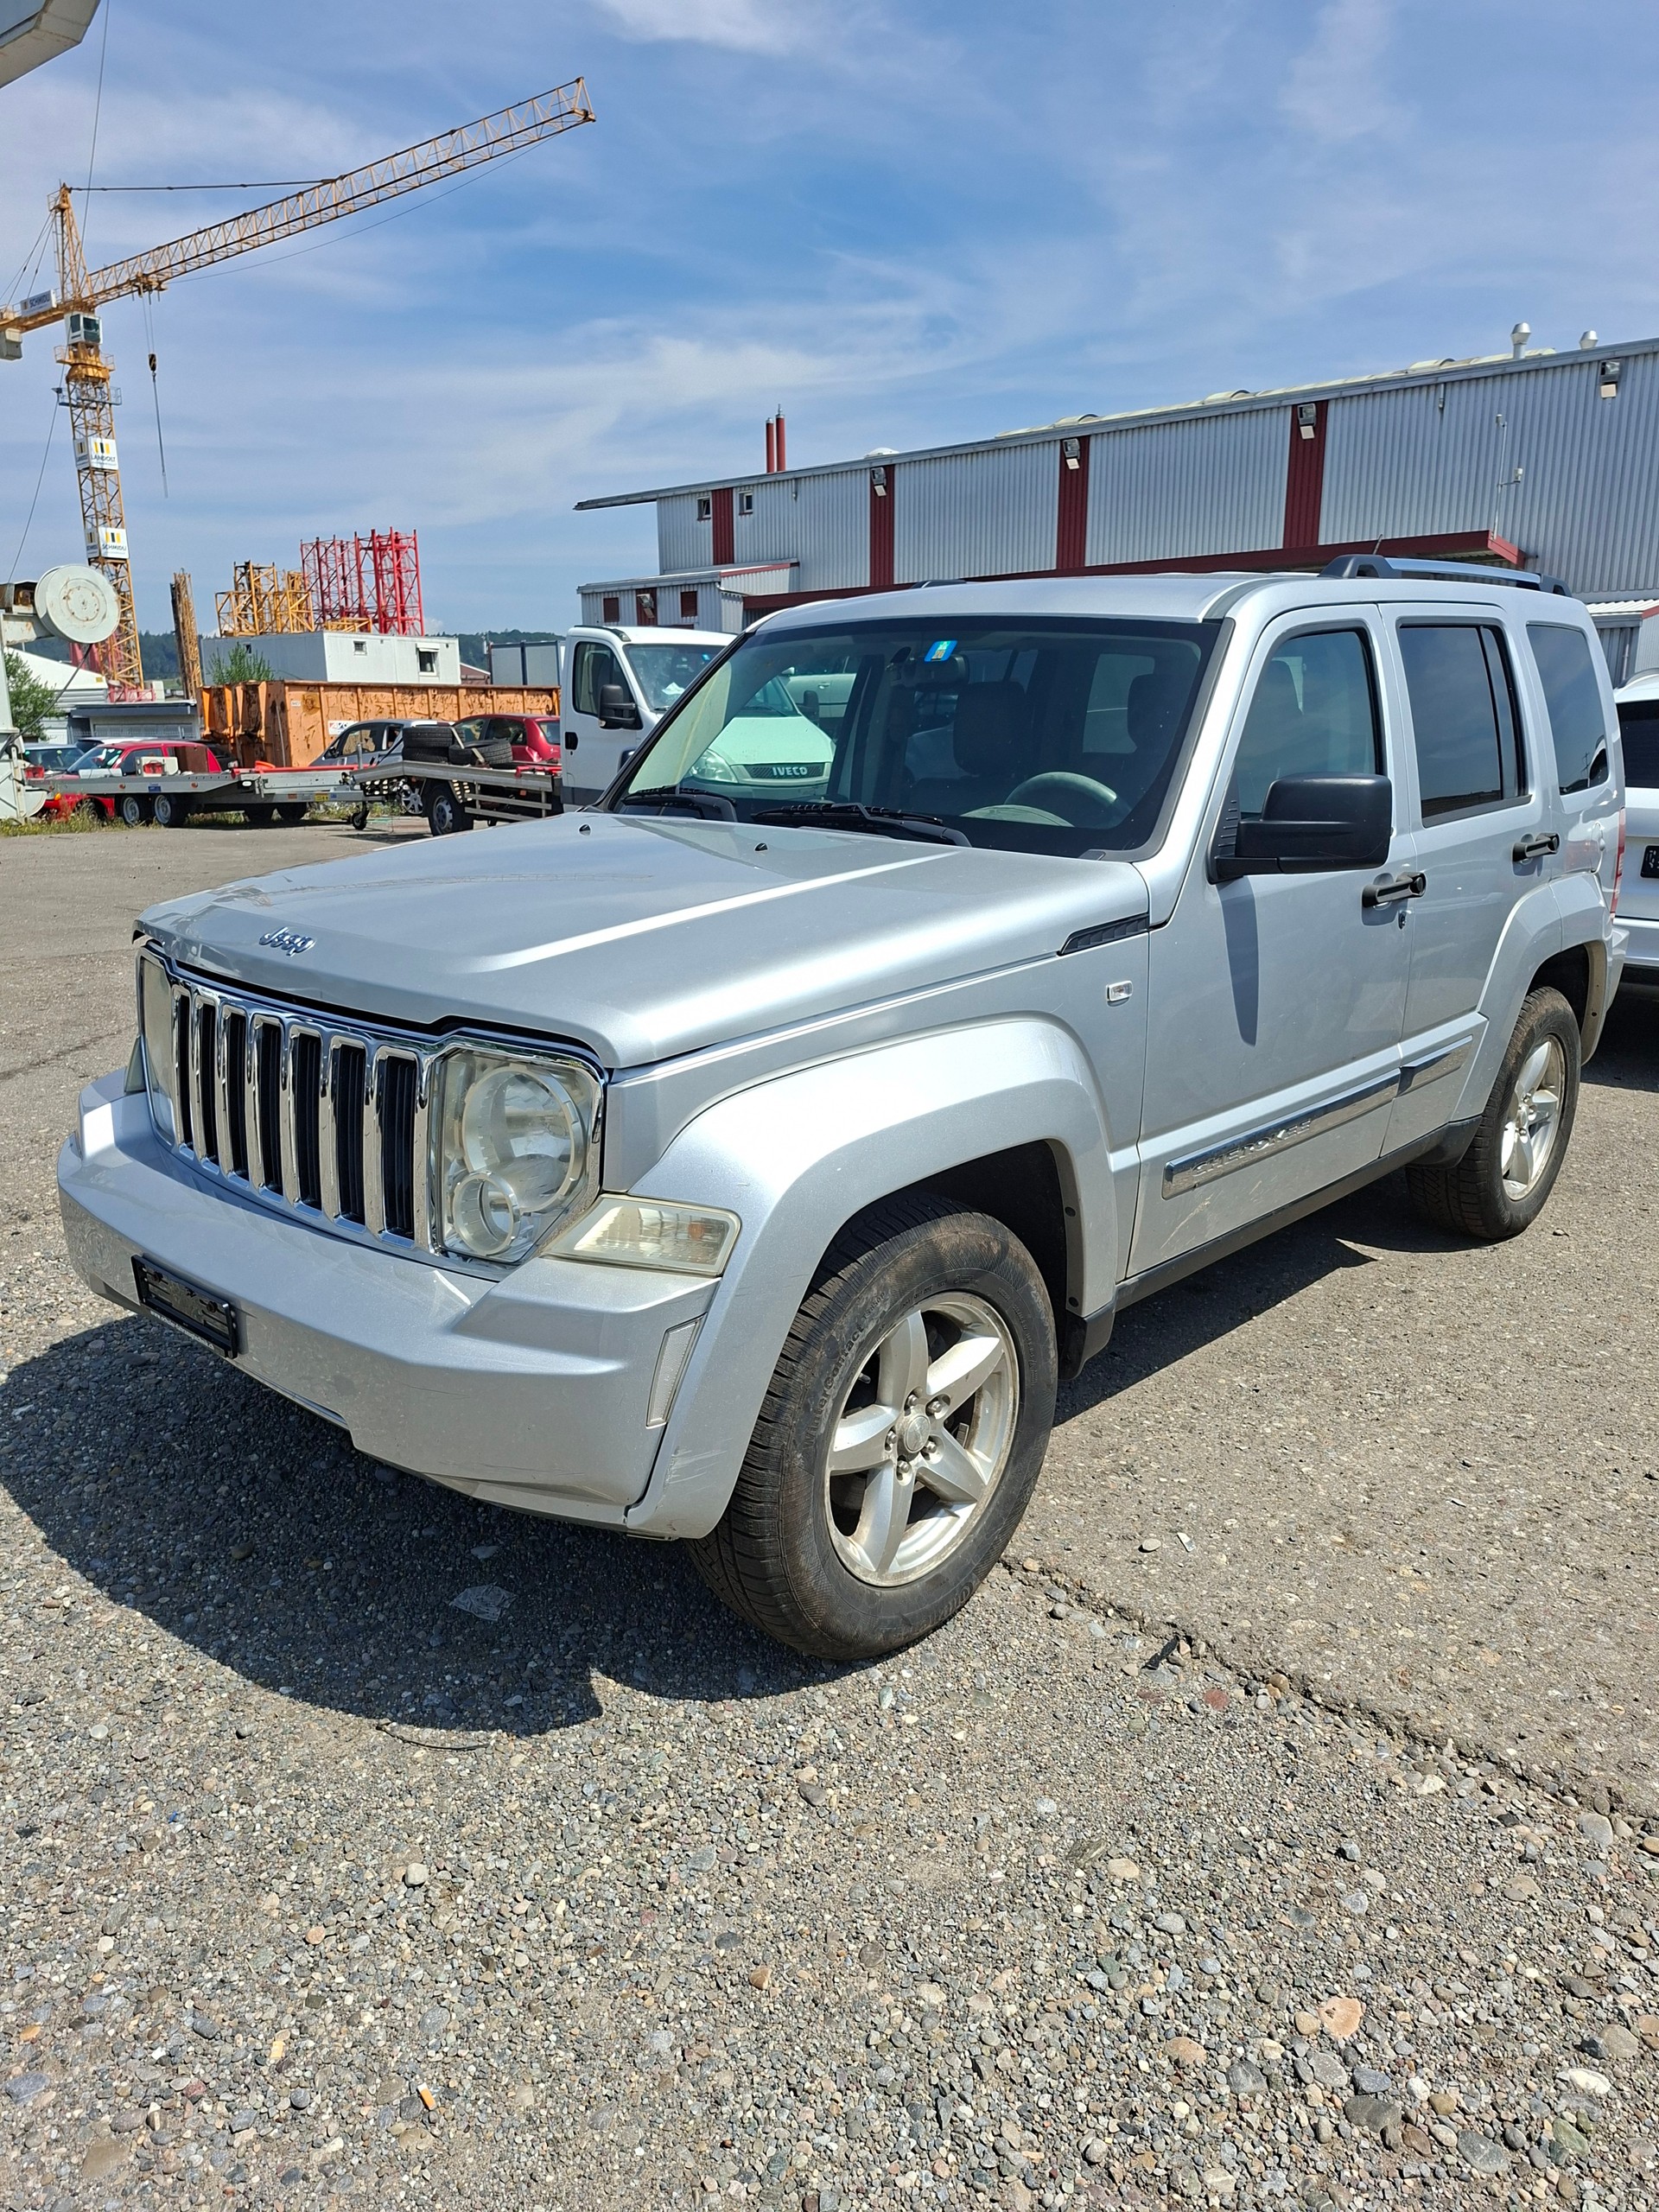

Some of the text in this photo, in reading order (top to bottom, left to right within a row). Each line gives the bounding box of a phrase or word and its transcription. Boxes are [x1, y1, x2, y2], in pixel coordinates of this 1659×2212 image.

[772, 766, 808, 776] IVECO
[258, 926, 315, 957] Jeep
[1192, 1119, 1312, 1177] CHEROKEE
